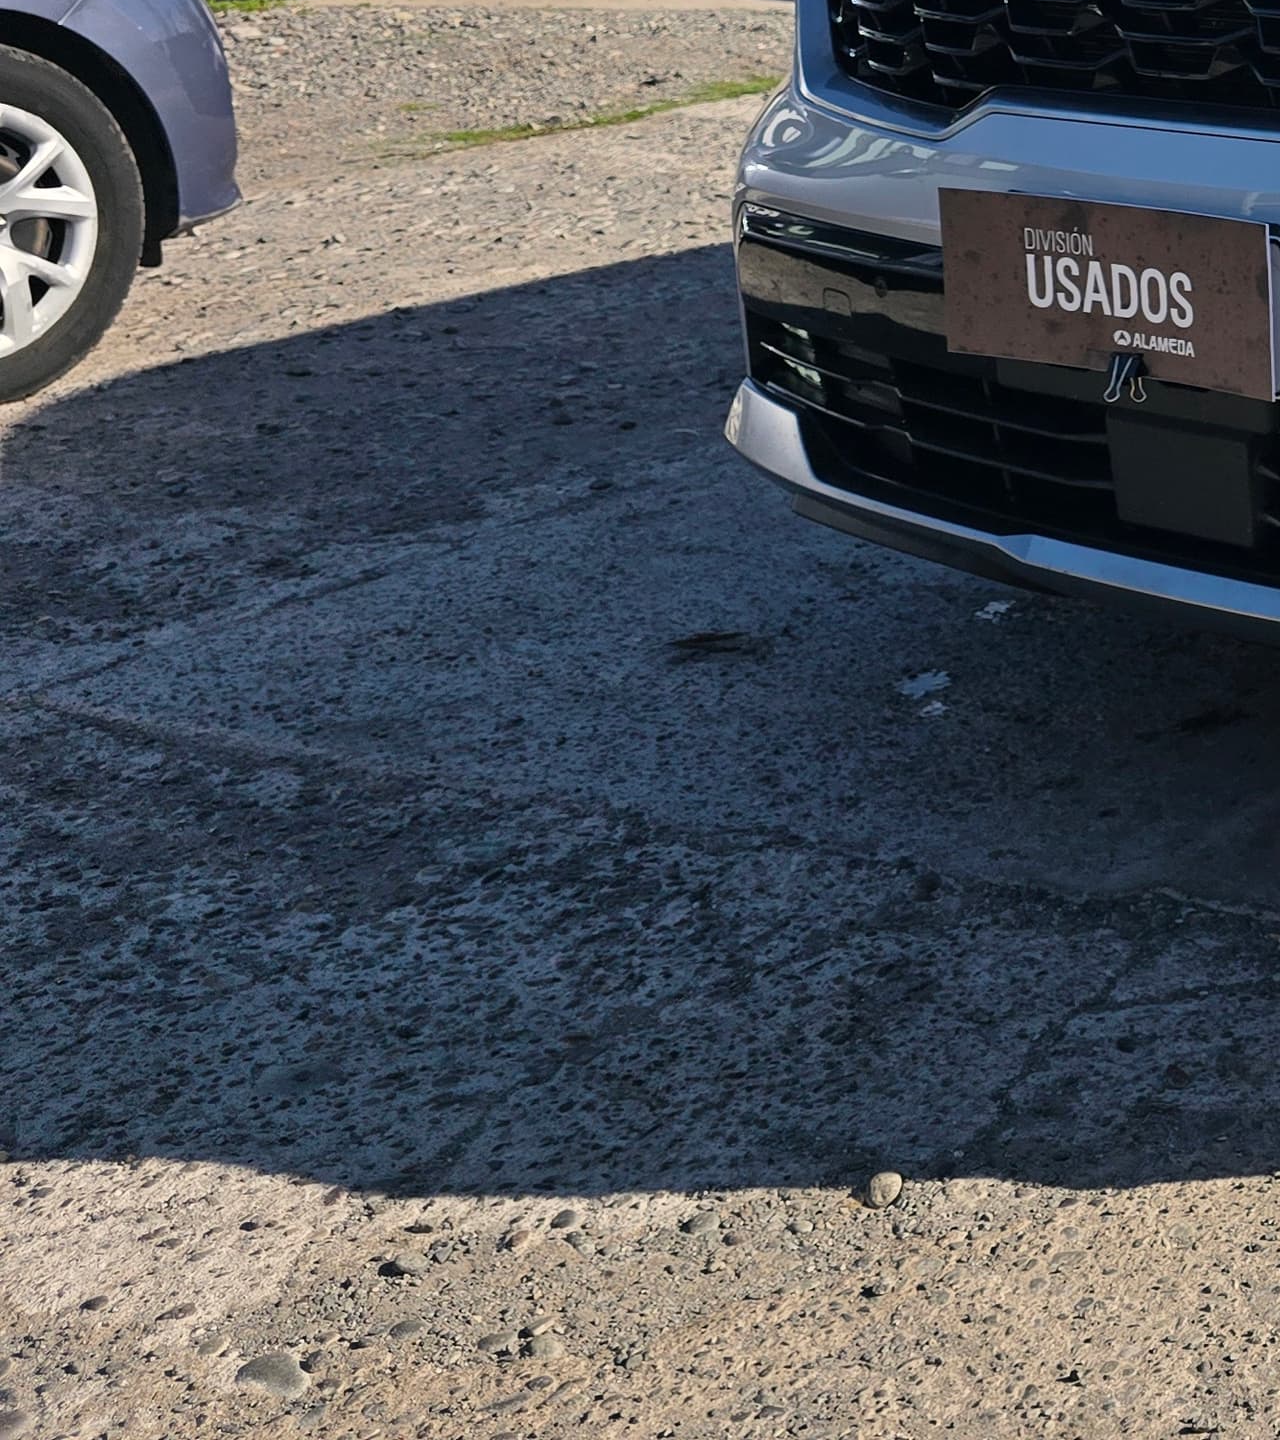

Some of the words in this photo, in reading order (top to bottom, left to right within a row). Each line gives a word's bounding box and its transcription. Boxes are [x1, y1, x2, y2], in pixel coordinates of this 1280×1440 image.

[1023, 227, 1094, 257] DIVISIÓN
[1025, 252, 1194, 329] USADOS
[1132, 332, 1196, 358] ALAMEDA
